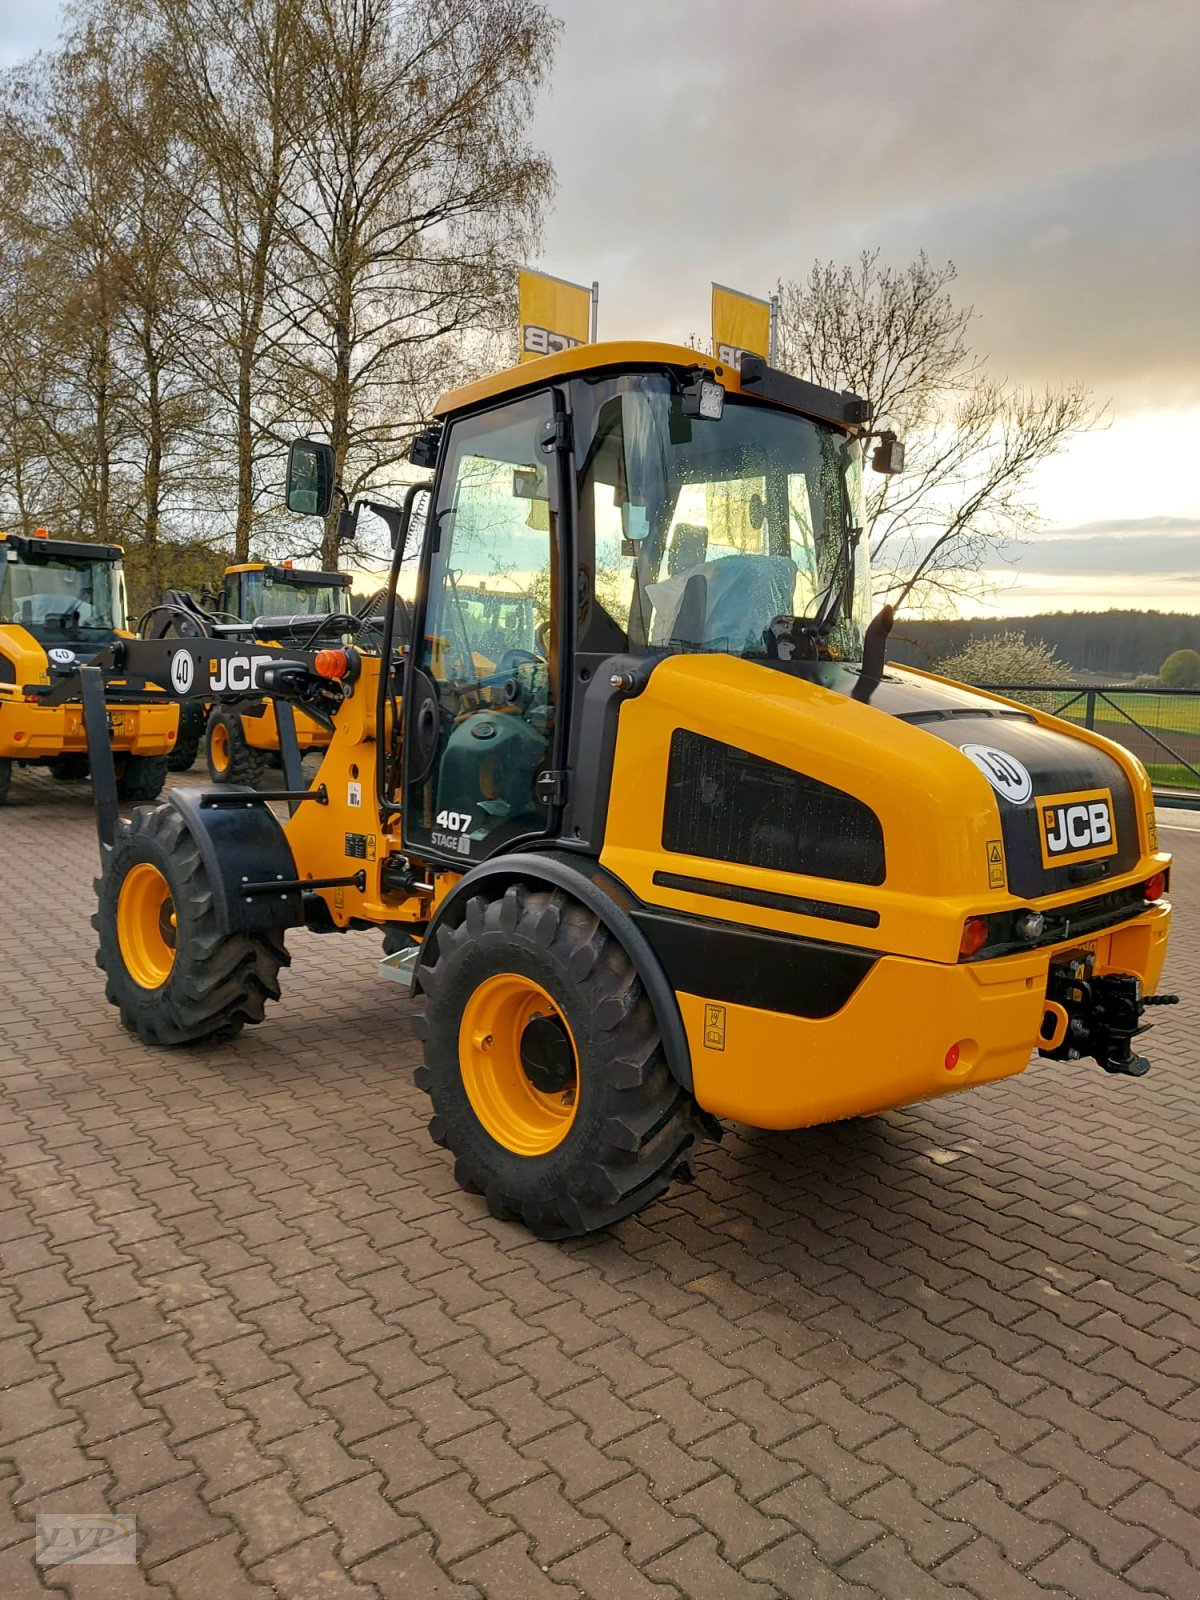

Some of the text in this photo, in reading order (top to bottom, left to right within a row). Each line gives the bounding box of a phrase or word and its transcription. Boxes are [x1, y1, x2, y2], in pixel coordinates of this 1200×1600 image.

[55, 650, 69, 660] 40
[176, 658, 188, 684] 40
[975, 751, 1023, 788] 40
[436, 810, 472, 832] 407
[1047, 803, 1112, 851] JCB
[431, 832, 458, 850] STAGE
